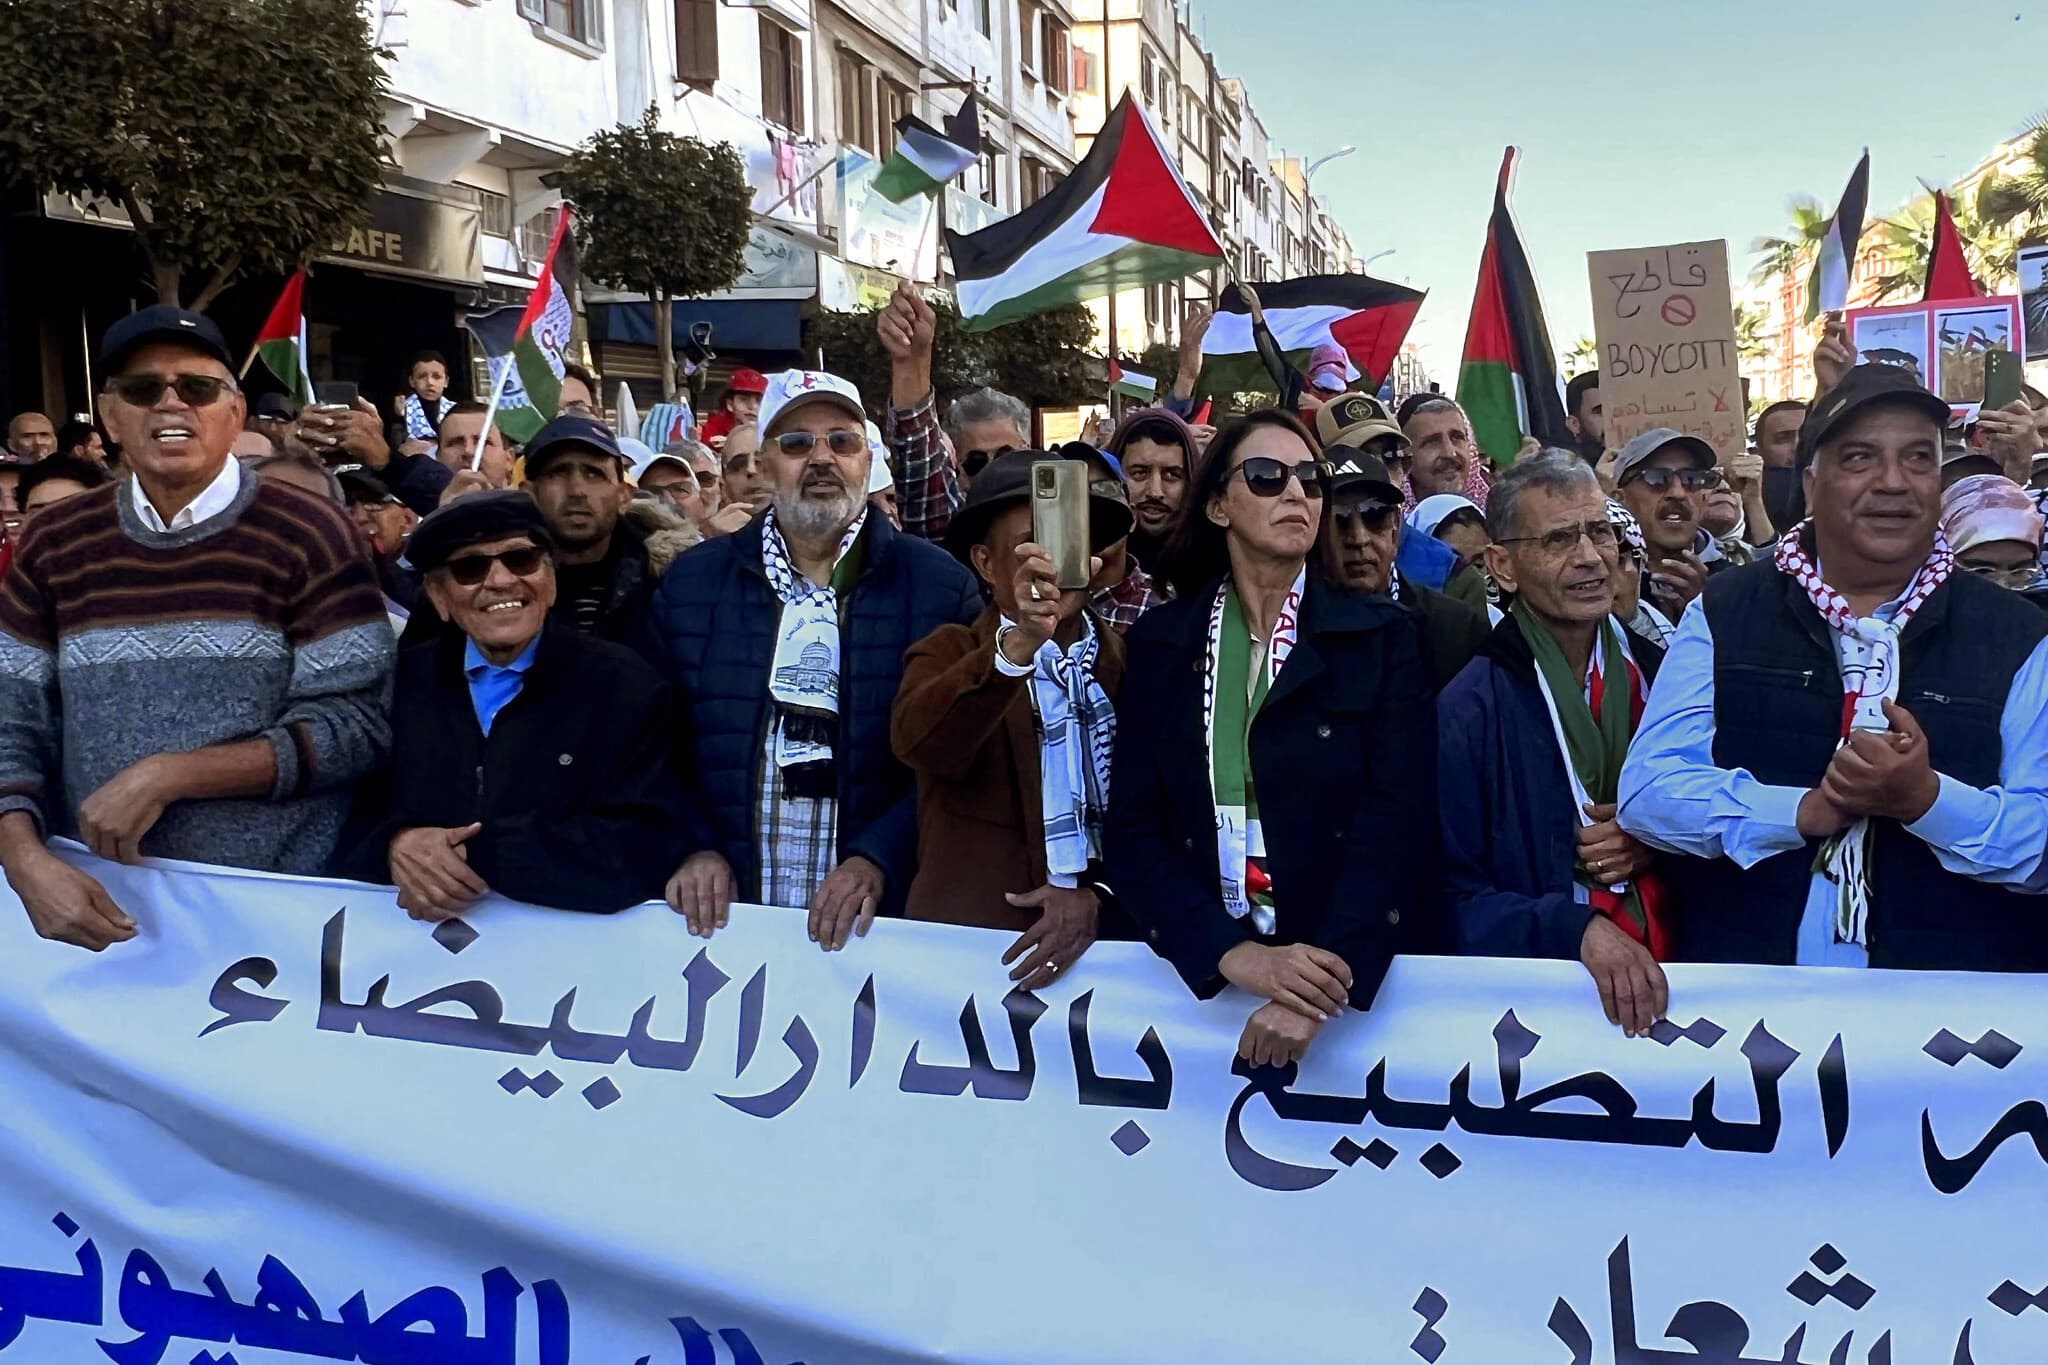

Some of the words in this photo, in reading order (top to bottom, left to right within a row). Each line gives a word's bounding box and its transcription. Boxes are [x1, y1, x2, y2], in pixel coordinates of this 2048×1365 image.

[1607, 338, 1729, 379] BOYCOTT
[197, 906, 766, 1111] البيضاء
[1224, 1008, 1850, 1192] التطبيع
